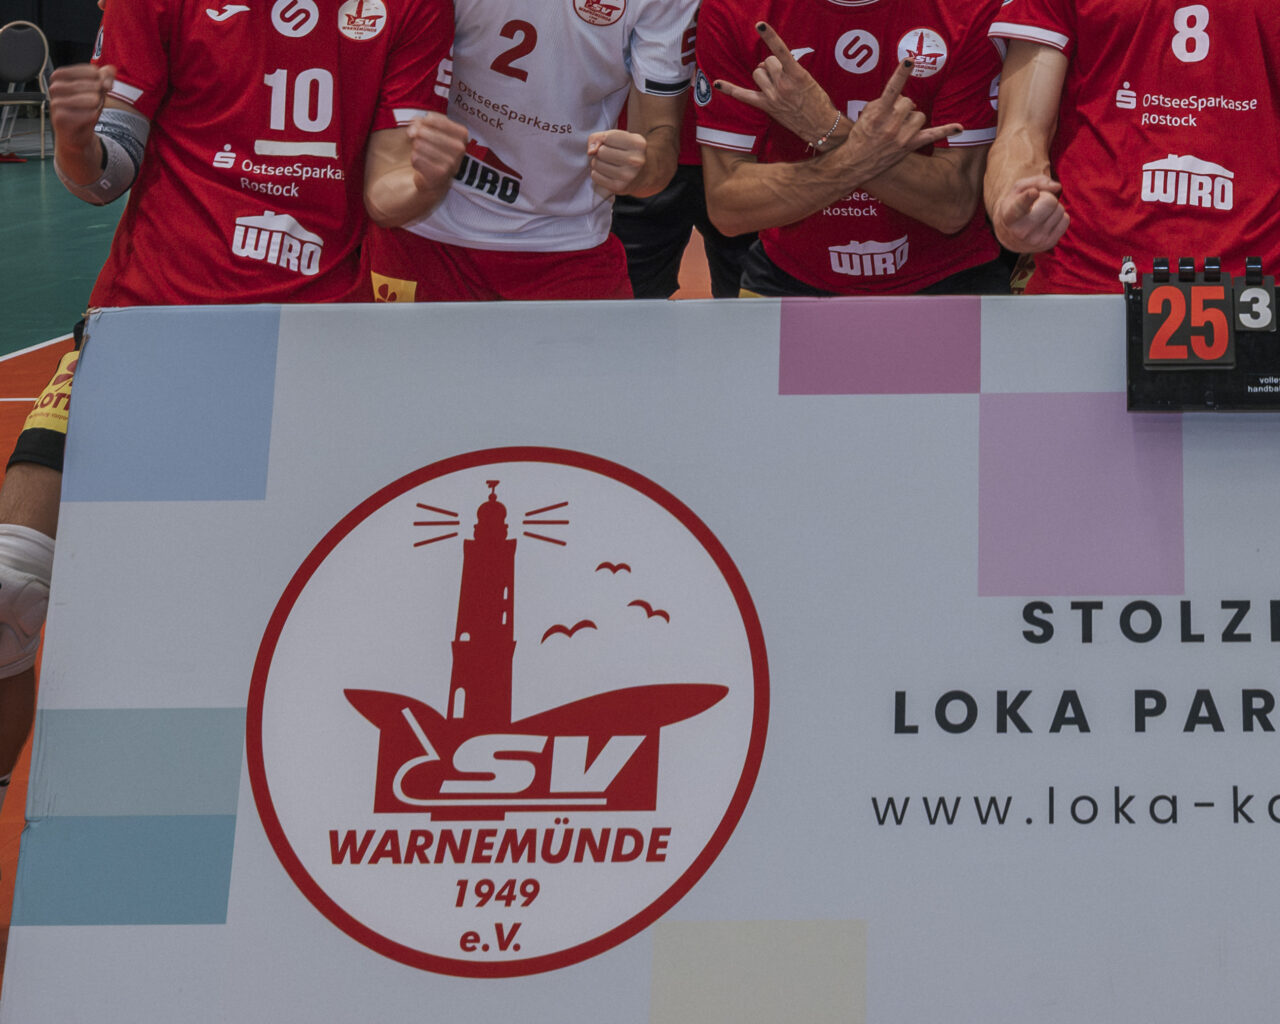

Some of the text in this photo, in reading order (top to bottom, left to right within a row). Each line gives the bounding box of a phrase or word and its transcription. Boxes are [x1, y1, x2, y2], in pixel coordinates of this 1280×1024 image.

[490, 19, 538, 82] 2
[1171, 4, 1210, 63] 8
[263, 67, 334, 133] 10
[454, 94, 505, 131] Rostock
[1141, 112, 1197, 126] Rostock
[1142, 93, 1258, 112] OstseeSparkasse
[240, 177, 299, 198] Rostock
[1141, 170, 1234, 211] WIRO
[231, 224, 324, 276] WIRO
[829, 242, 909, 276] WIRO
[1147, 284, 1229, 361] 25
[1238, 287, 1272, 329] 3
[893, 688, 1091, 735] LOKA
[438, 733, 648, 794] SV
[328, 817, 672, 866] WARNEMÜNDE
[455, 878, 541, 908] 1949
[459, 922, 523, 952] e.V.
